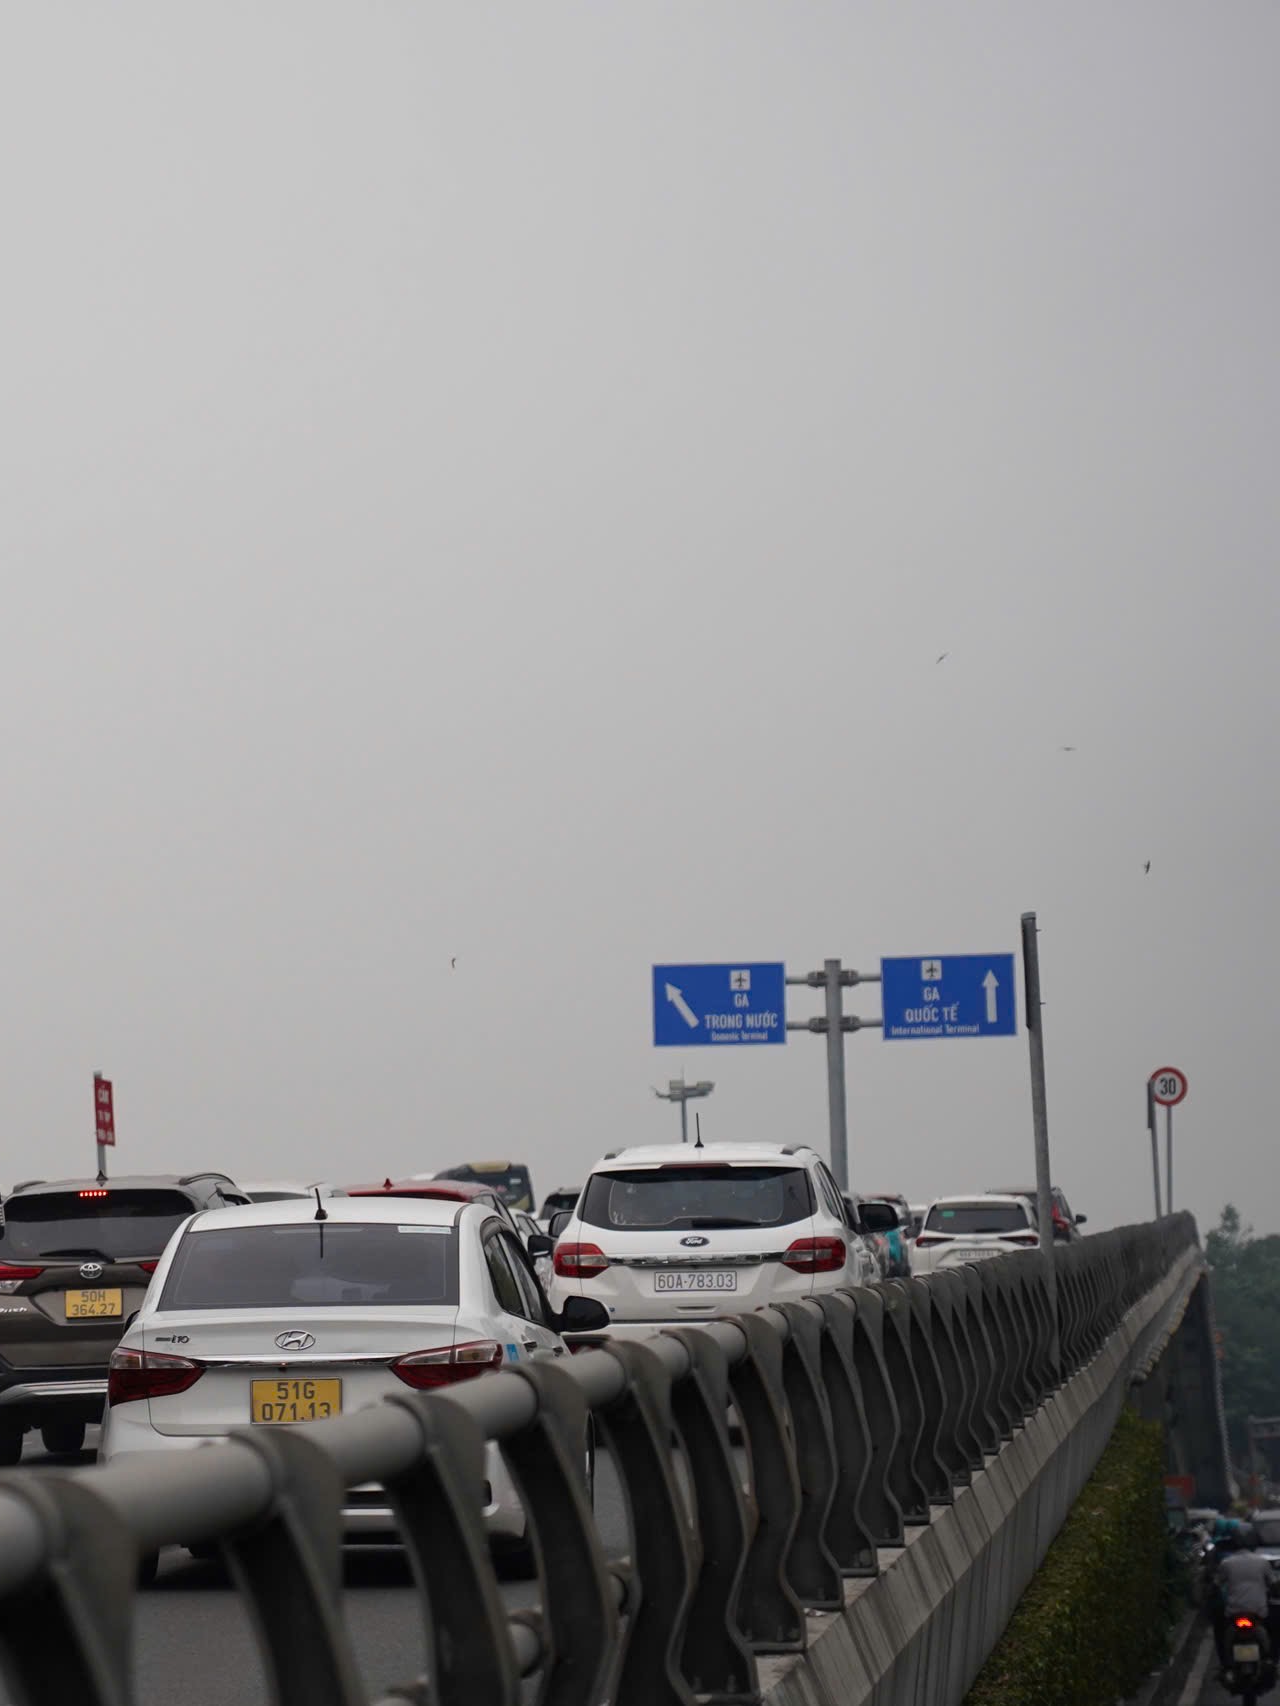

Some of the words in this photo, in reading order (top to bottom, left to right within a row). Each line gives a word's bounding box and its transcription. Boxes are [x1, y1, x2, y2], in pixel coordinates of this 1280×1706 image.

[734, 992, 750, 1008] GA
[923, 986, 941, 1002] GA
[705, 1013, 744, 1029] TRONG
[745, 1010, 778, 1029] NƯỚC
[905, 1003, 939, 1023] QUỐC
[942, 1001, 960, 1021] TẾ
[891, 1024, 942, 1035] International
[946, 1023, 979, 1034] Terminal
[1160, 1077, 1176, 1096] 30
[81, 1290, 106, 1303] 50H
[72, 1303, 115, 1316] 364.27
[277, 1382, 315, 1400] 51G
[261, 1402, 331, 1421] 071.13
